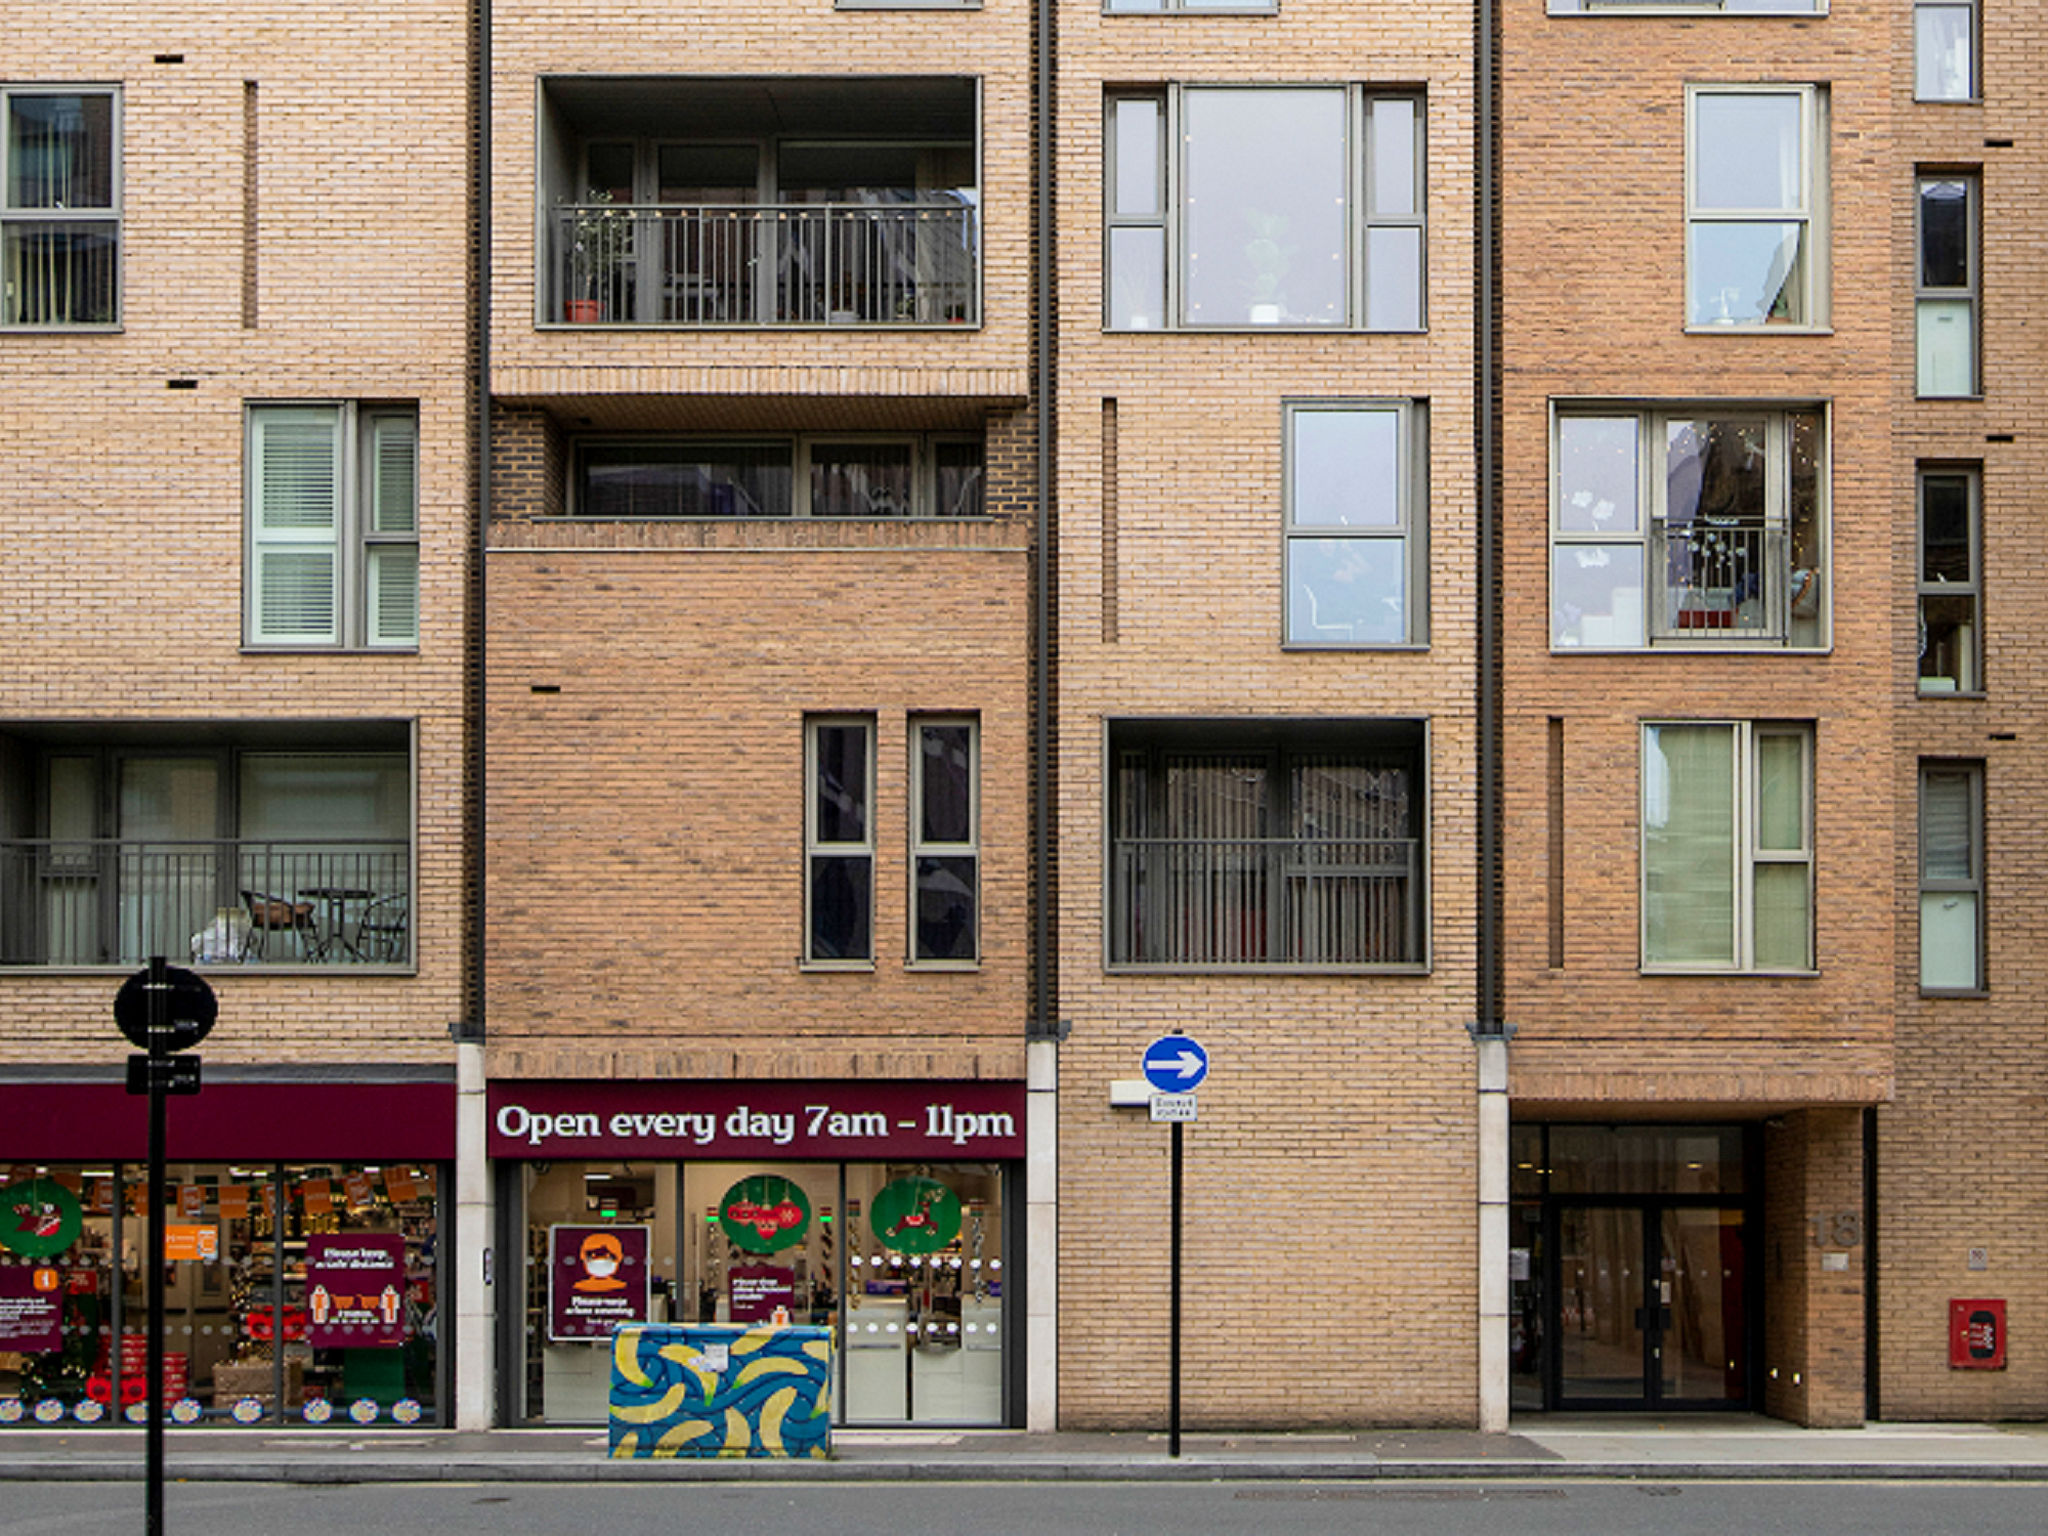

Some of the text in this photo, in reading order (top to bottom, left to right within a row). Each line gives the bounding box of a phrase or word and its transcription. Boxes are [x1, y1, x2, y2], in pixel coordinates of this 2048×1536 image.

[496, 1105, 602, 1145] Open
[609, 1112, 716, 1145] every
[725, 1105, 795, 1145] day
[805, 1105, 889, 1137] 7am
[925, 1104, 1017, 1145] 11pm
[1808, 1210, 1861, 1246] 18
